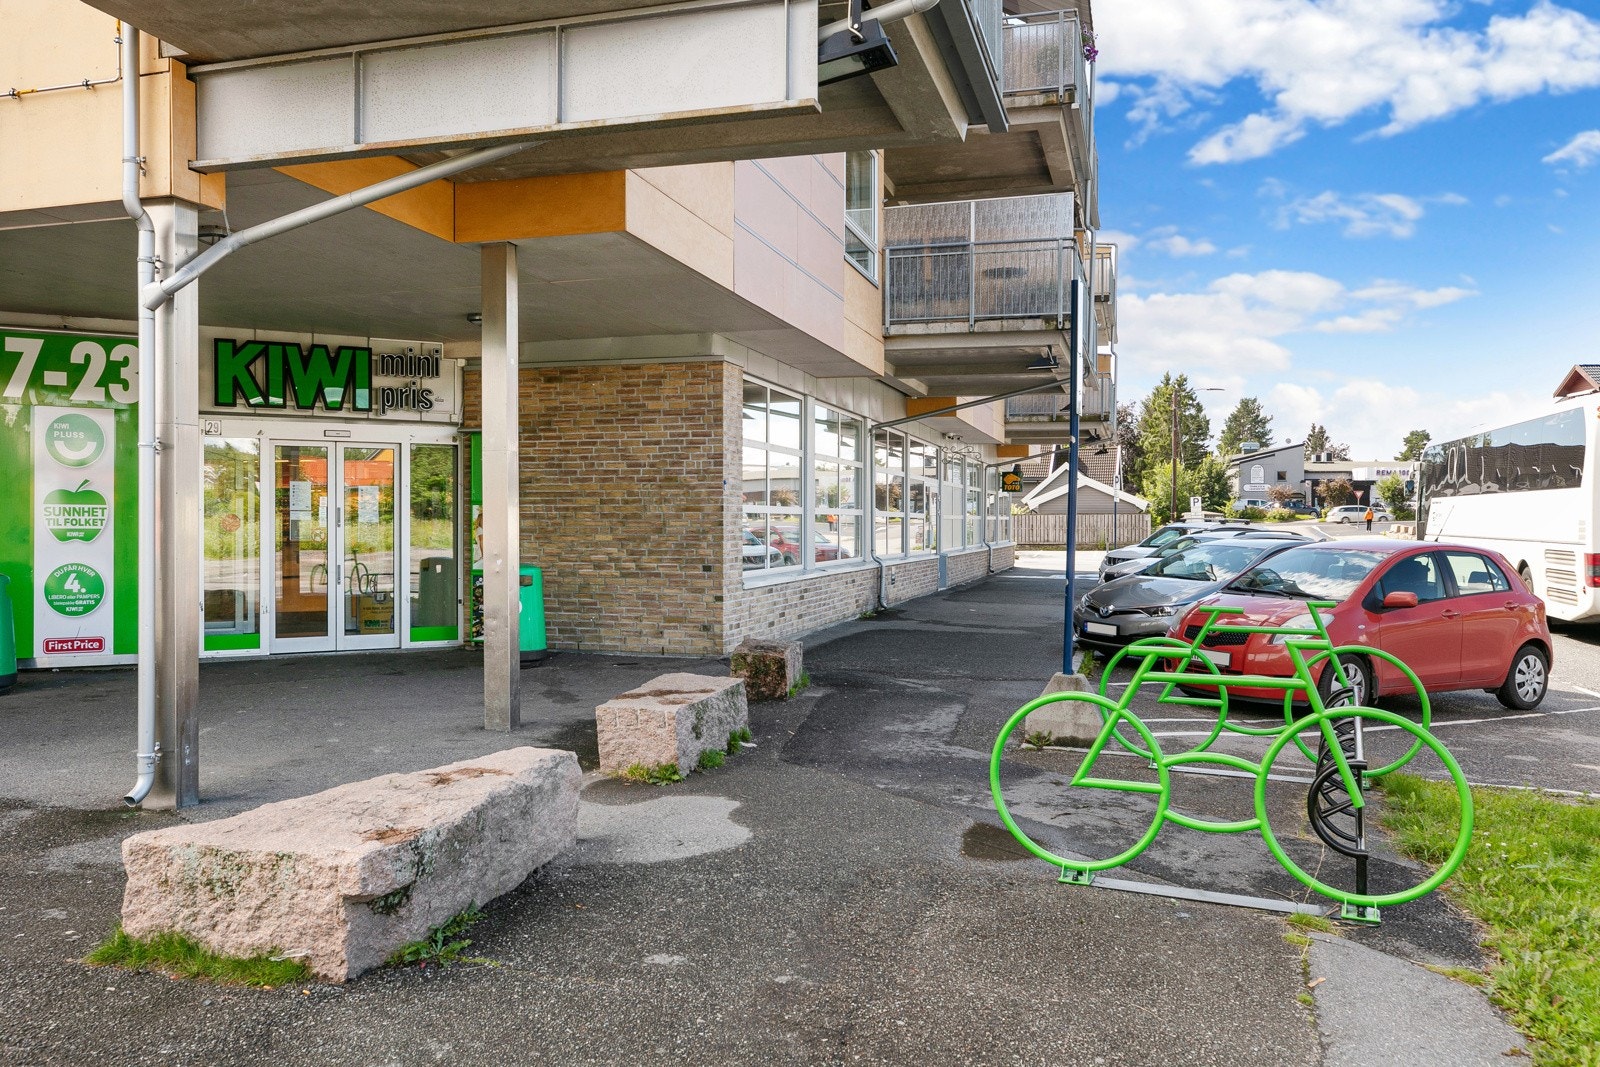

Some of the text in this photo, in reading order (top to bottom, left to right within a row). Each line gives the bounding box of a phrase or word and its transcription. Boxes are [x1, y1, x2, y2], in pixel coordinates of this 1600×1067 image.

[380, 347, 441, 378] mini
[2, 337, 139, 404] 7-23
[214, 338, 372, 412] KIWI
[380, 380, 433, 416] pris
[207, 421, 219, 433] 29
[1193, 498, 1200, 507] P
[43, 506, 107, 517] SUNNHET
[45, 518, 105, 526] TIL FOLKET
[54, 564, 96, 578] DU FÅR HVER
[64, 573, 87, 593] 4.
[48, 640, 99, 650] First Price
